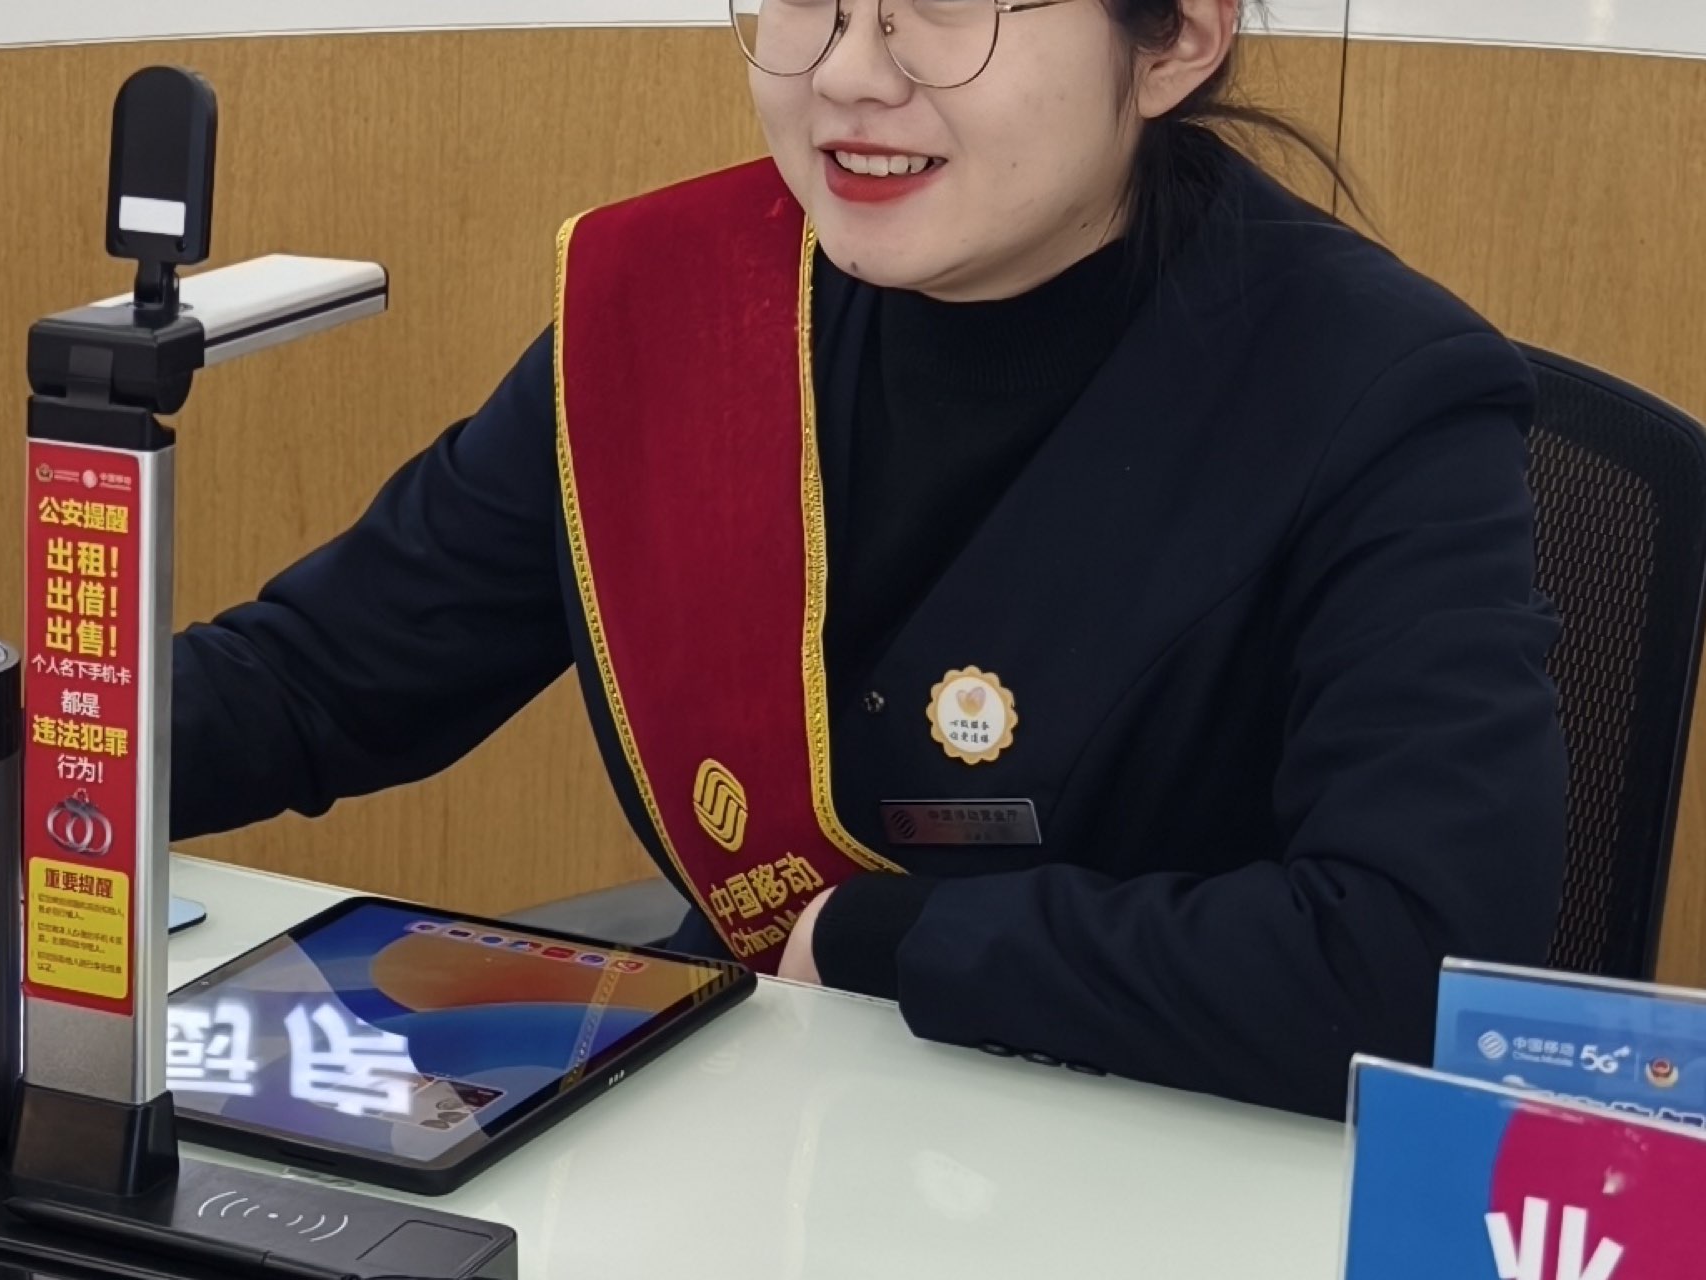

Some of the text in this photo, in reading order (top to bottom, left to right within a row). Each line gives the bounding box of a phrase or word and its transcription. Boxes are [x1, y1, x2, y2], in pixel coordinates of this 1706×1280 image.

[38, 495, 129, 534] 公安提醒
[46, 536, 119, 579] 出租！
[45, 576, 118, 618] 出借！
[45, 615, 117, 658] 出售！
[31, 653, 133, 686] 个人名下手机卡
[61, 688, 100, 719] 都是
[32, 714, 129, 758] 违法犯罪
[57, 753, 104, 784] 行为！
[44, 867, 114, 900] 重要提醒
[709, 851, 824, 926] 中国移动
[730, 925, 786, 958] China
[1512, 1036, 1575, 1058] 中国移动
